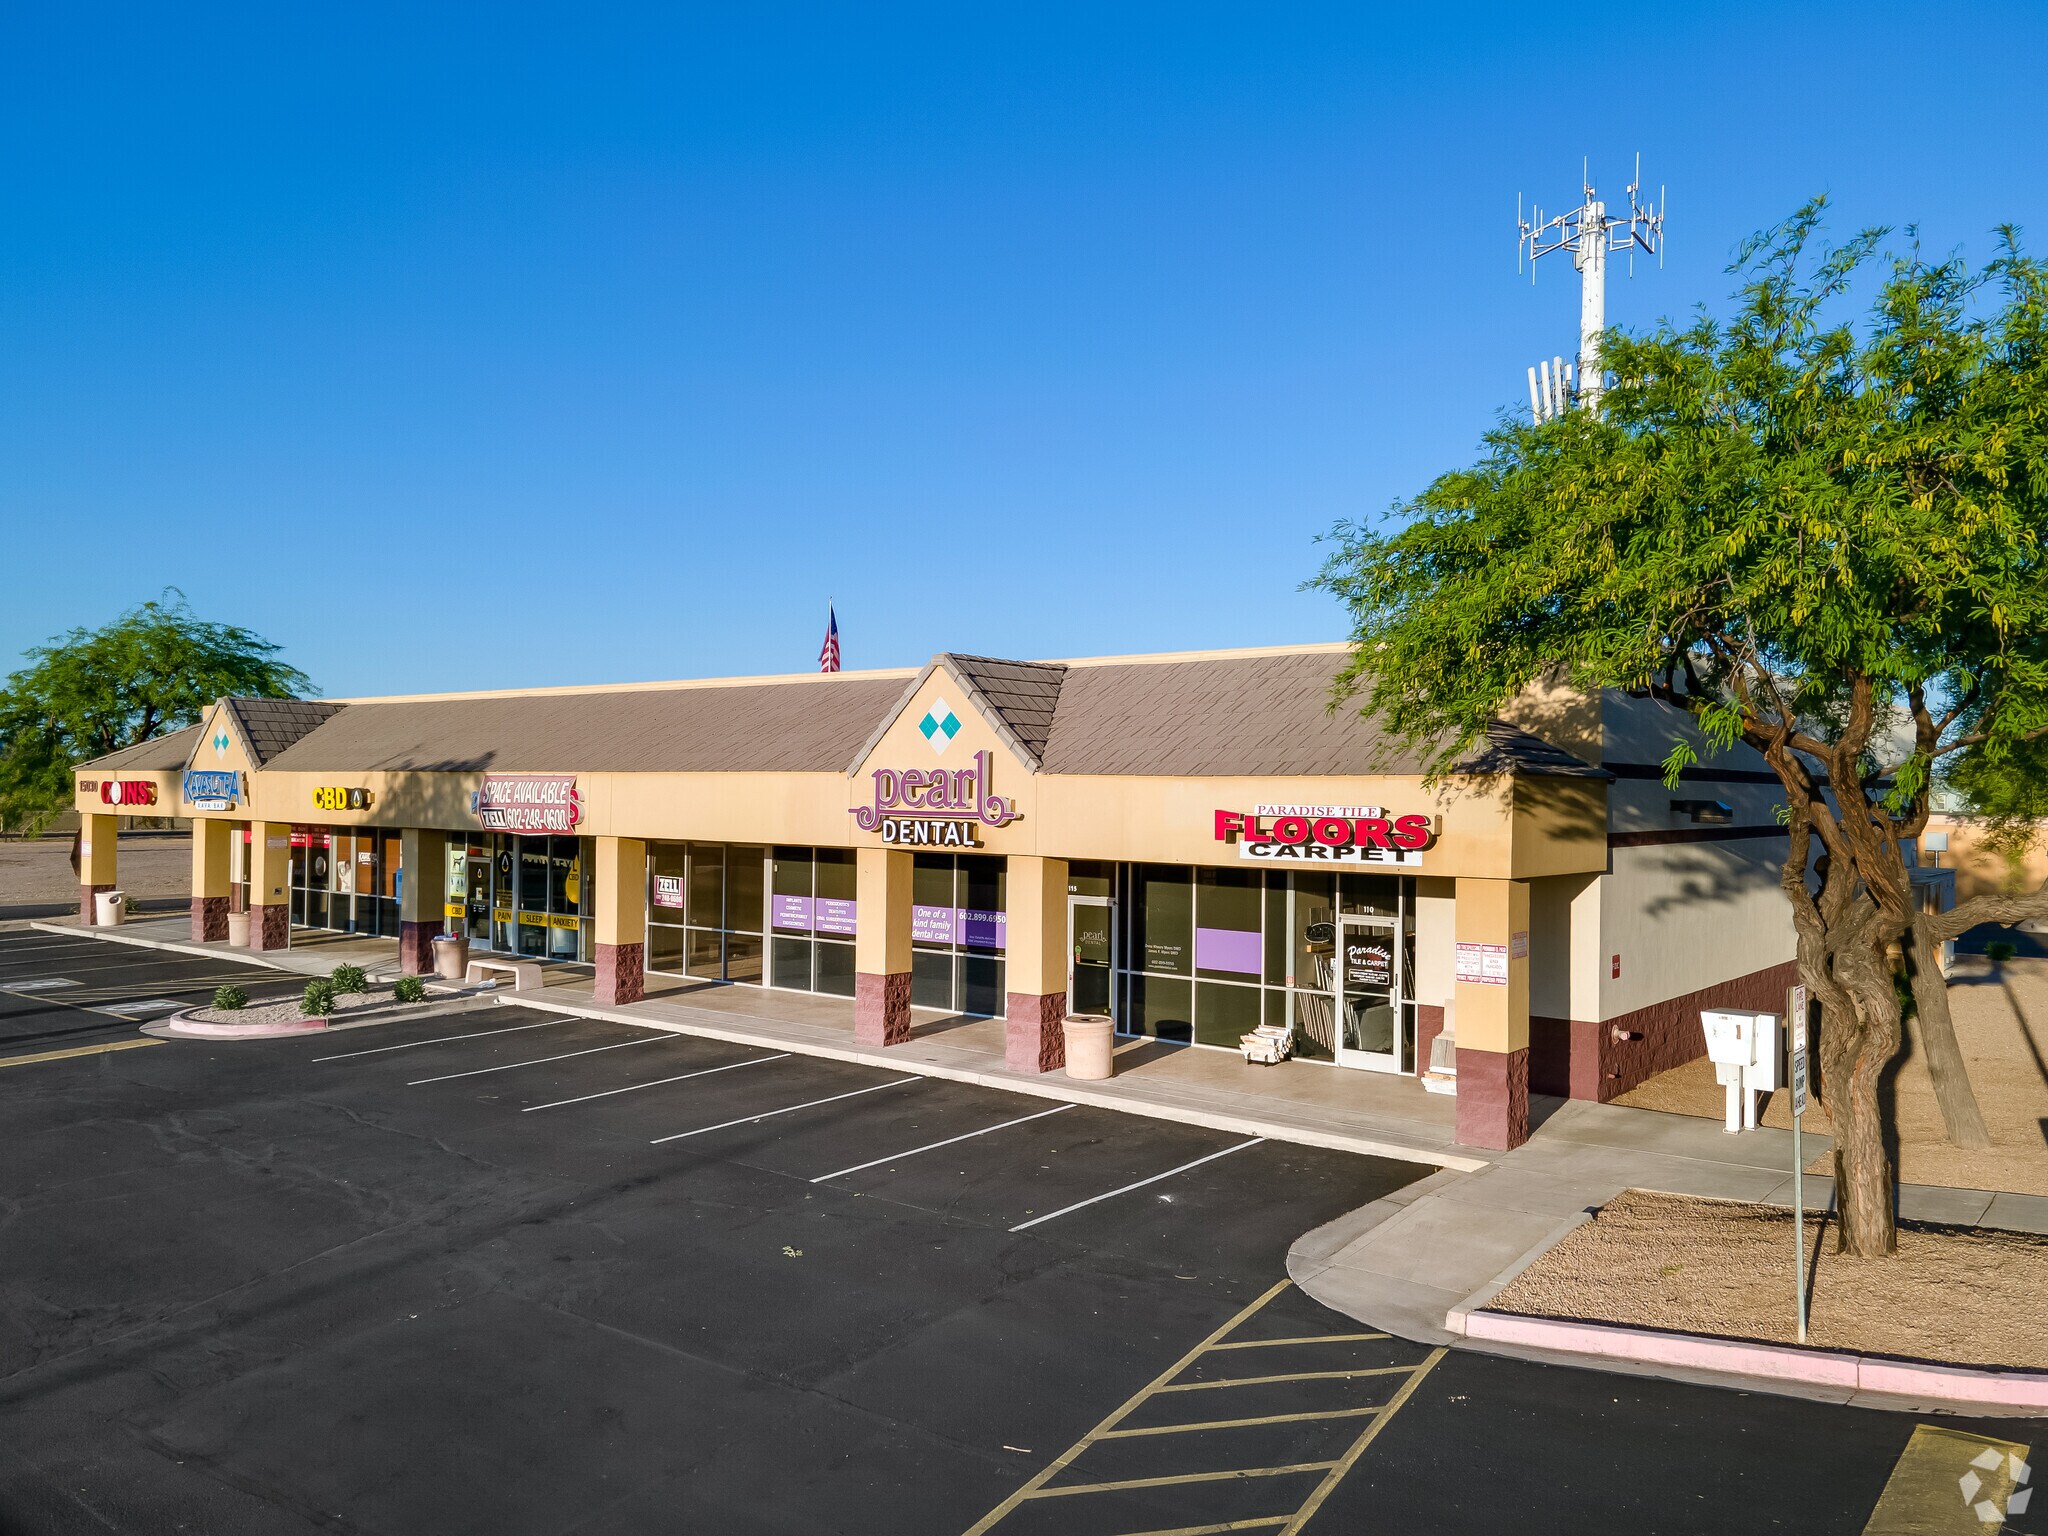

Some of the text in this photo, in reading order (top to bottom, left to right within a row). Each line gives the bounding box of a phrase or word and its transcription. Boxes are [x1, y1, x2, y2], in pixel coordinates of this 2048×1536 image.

[101, 781, 149, 805] COINS
[483, 781, 515, 804] SPACE
[513, 781, 570, 804] AVAILABLE
[856, 749, 1008, 831] pearl
[312, 787, 347, 810] CBD
[1257, 805, 1378, 818] PARADISE TILE
[506, 807, 569, 831] 602-248-0600
[882, 819, 976, 847] DENTAL
[1214, 809, 1430, 849] FLOORS
[1248, 844, 1413, 863] CARPET
[659, 878, 679, 893] ZELL
[451, 906, 463, 915] CBD
[497, 911, 512, 920] PAIN
[917, 908, 947, 919] One of a
[1363, 905, 1375, 914] 110
[525, 914, 543, 924] SLEEP
[552, 917, 578, 928] ANXIETY
[959, 912, 1007, 924] 602.899.6950
[912, 919, 952, 932] kind family
[911, 929, 950, 940] dental care
[1347, 945, 1391, 961] Paradise
[1367, 960, 1388, 968] CARPET
[1794, 1056, 1805, 1073] SPEED
